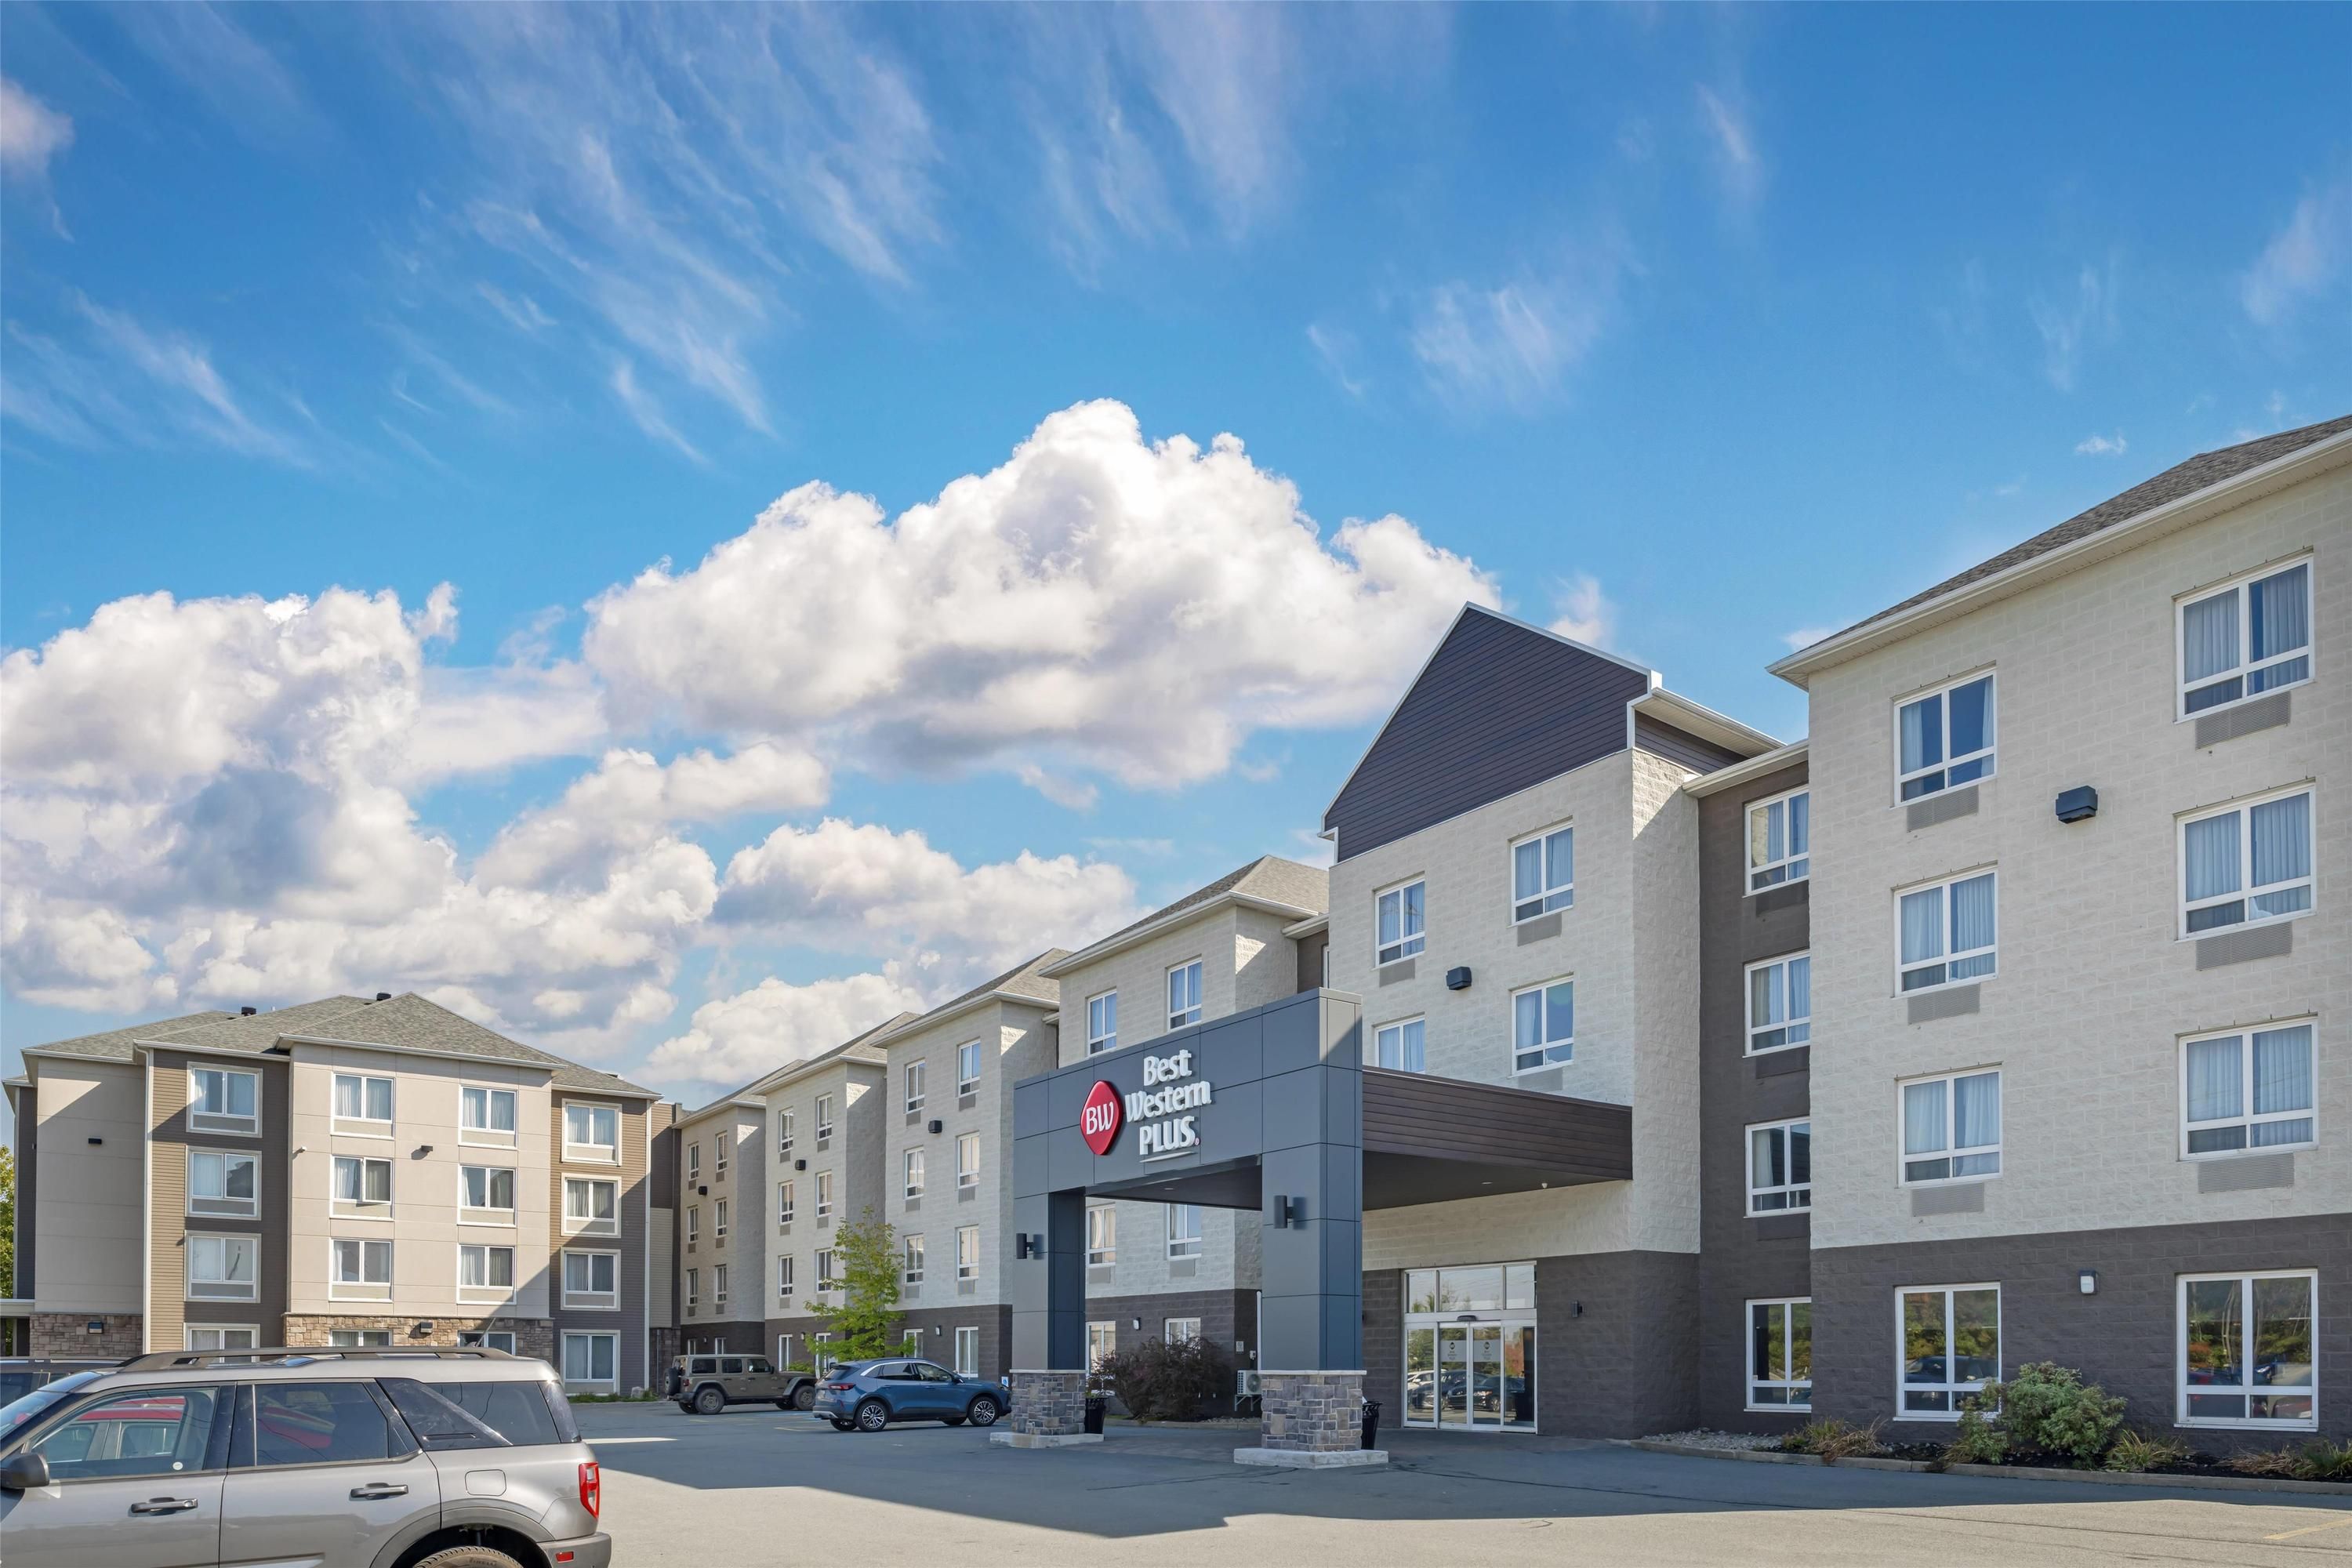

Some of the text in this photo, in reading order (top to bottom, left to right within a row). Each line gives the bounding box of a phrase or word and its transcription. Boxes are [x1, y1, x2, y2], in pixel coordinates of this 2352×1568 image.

[1144, 1049, 1192, 1087] Best
[1086, 1102, 1114, 1135] BW
[1124, 1080, 1212, 1123] Western
